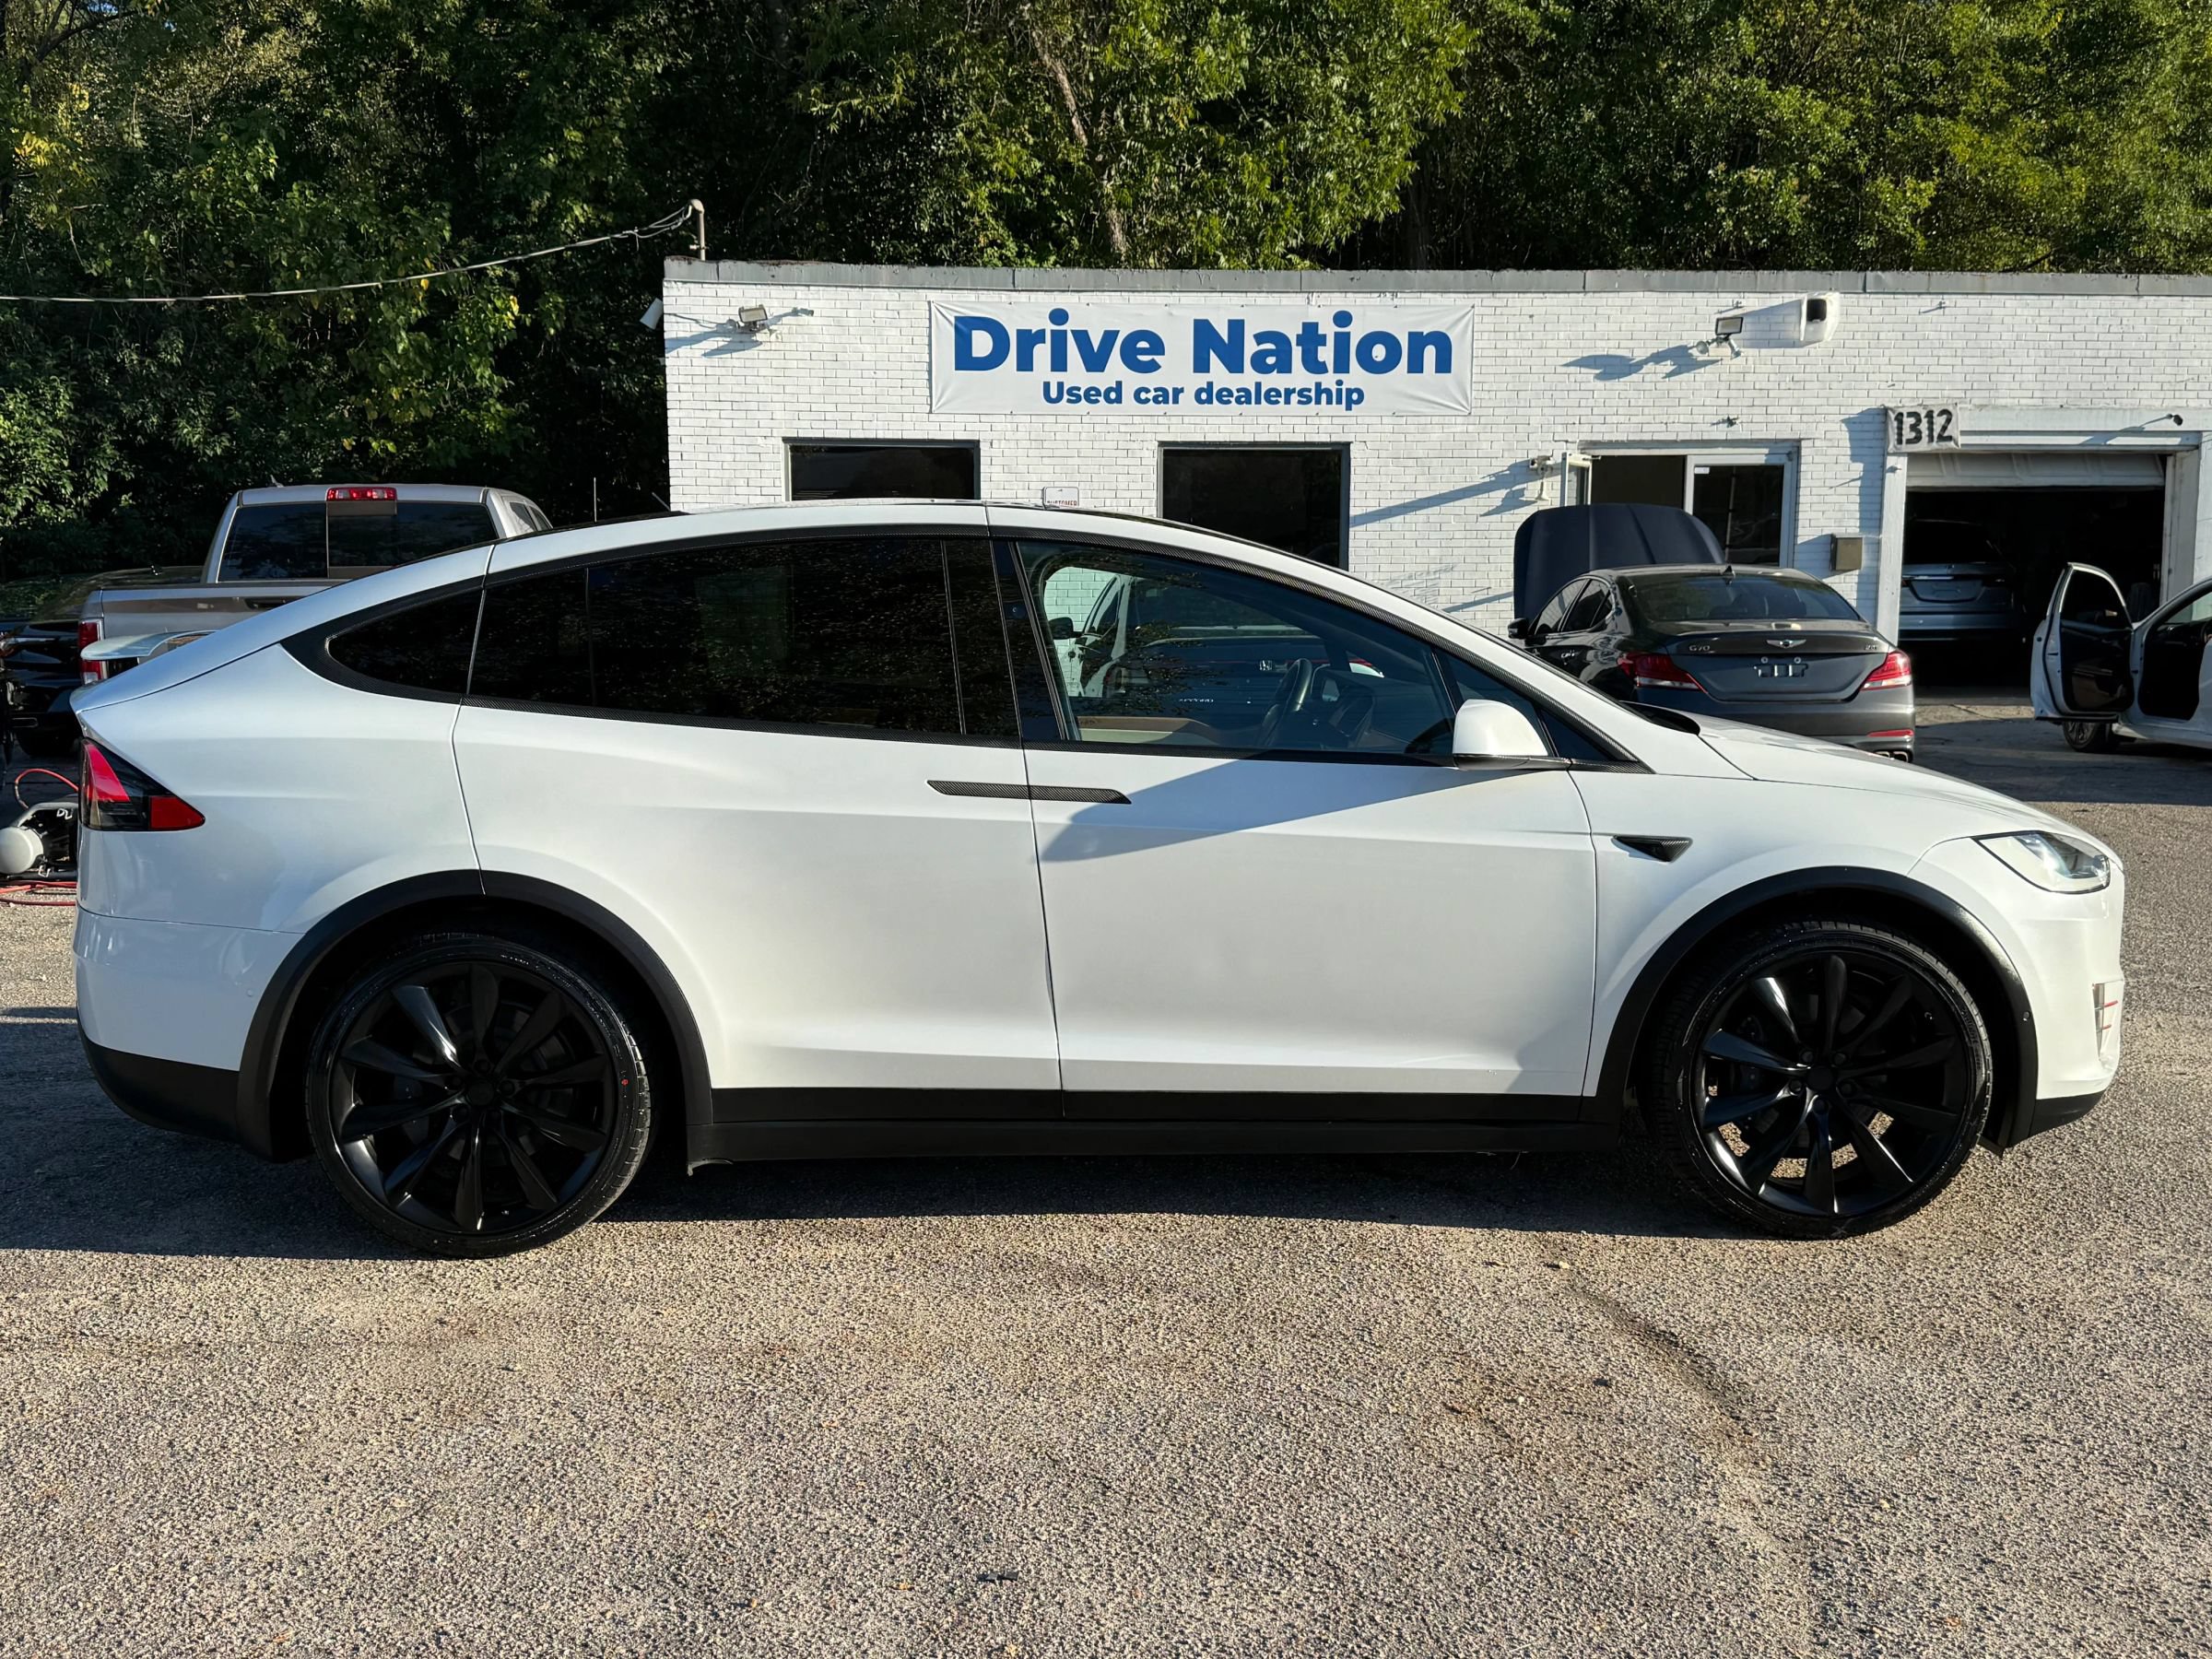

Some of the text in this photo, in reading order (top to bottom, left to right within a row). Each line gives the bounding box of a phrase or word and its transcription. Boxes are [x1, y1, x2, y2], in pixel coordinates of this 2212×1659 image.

[954, 309, 1453, 375] Drive Nation
[1042, 379, 1365, 411] Used car dealership
[1893, 408, 1953, 445] 1312
